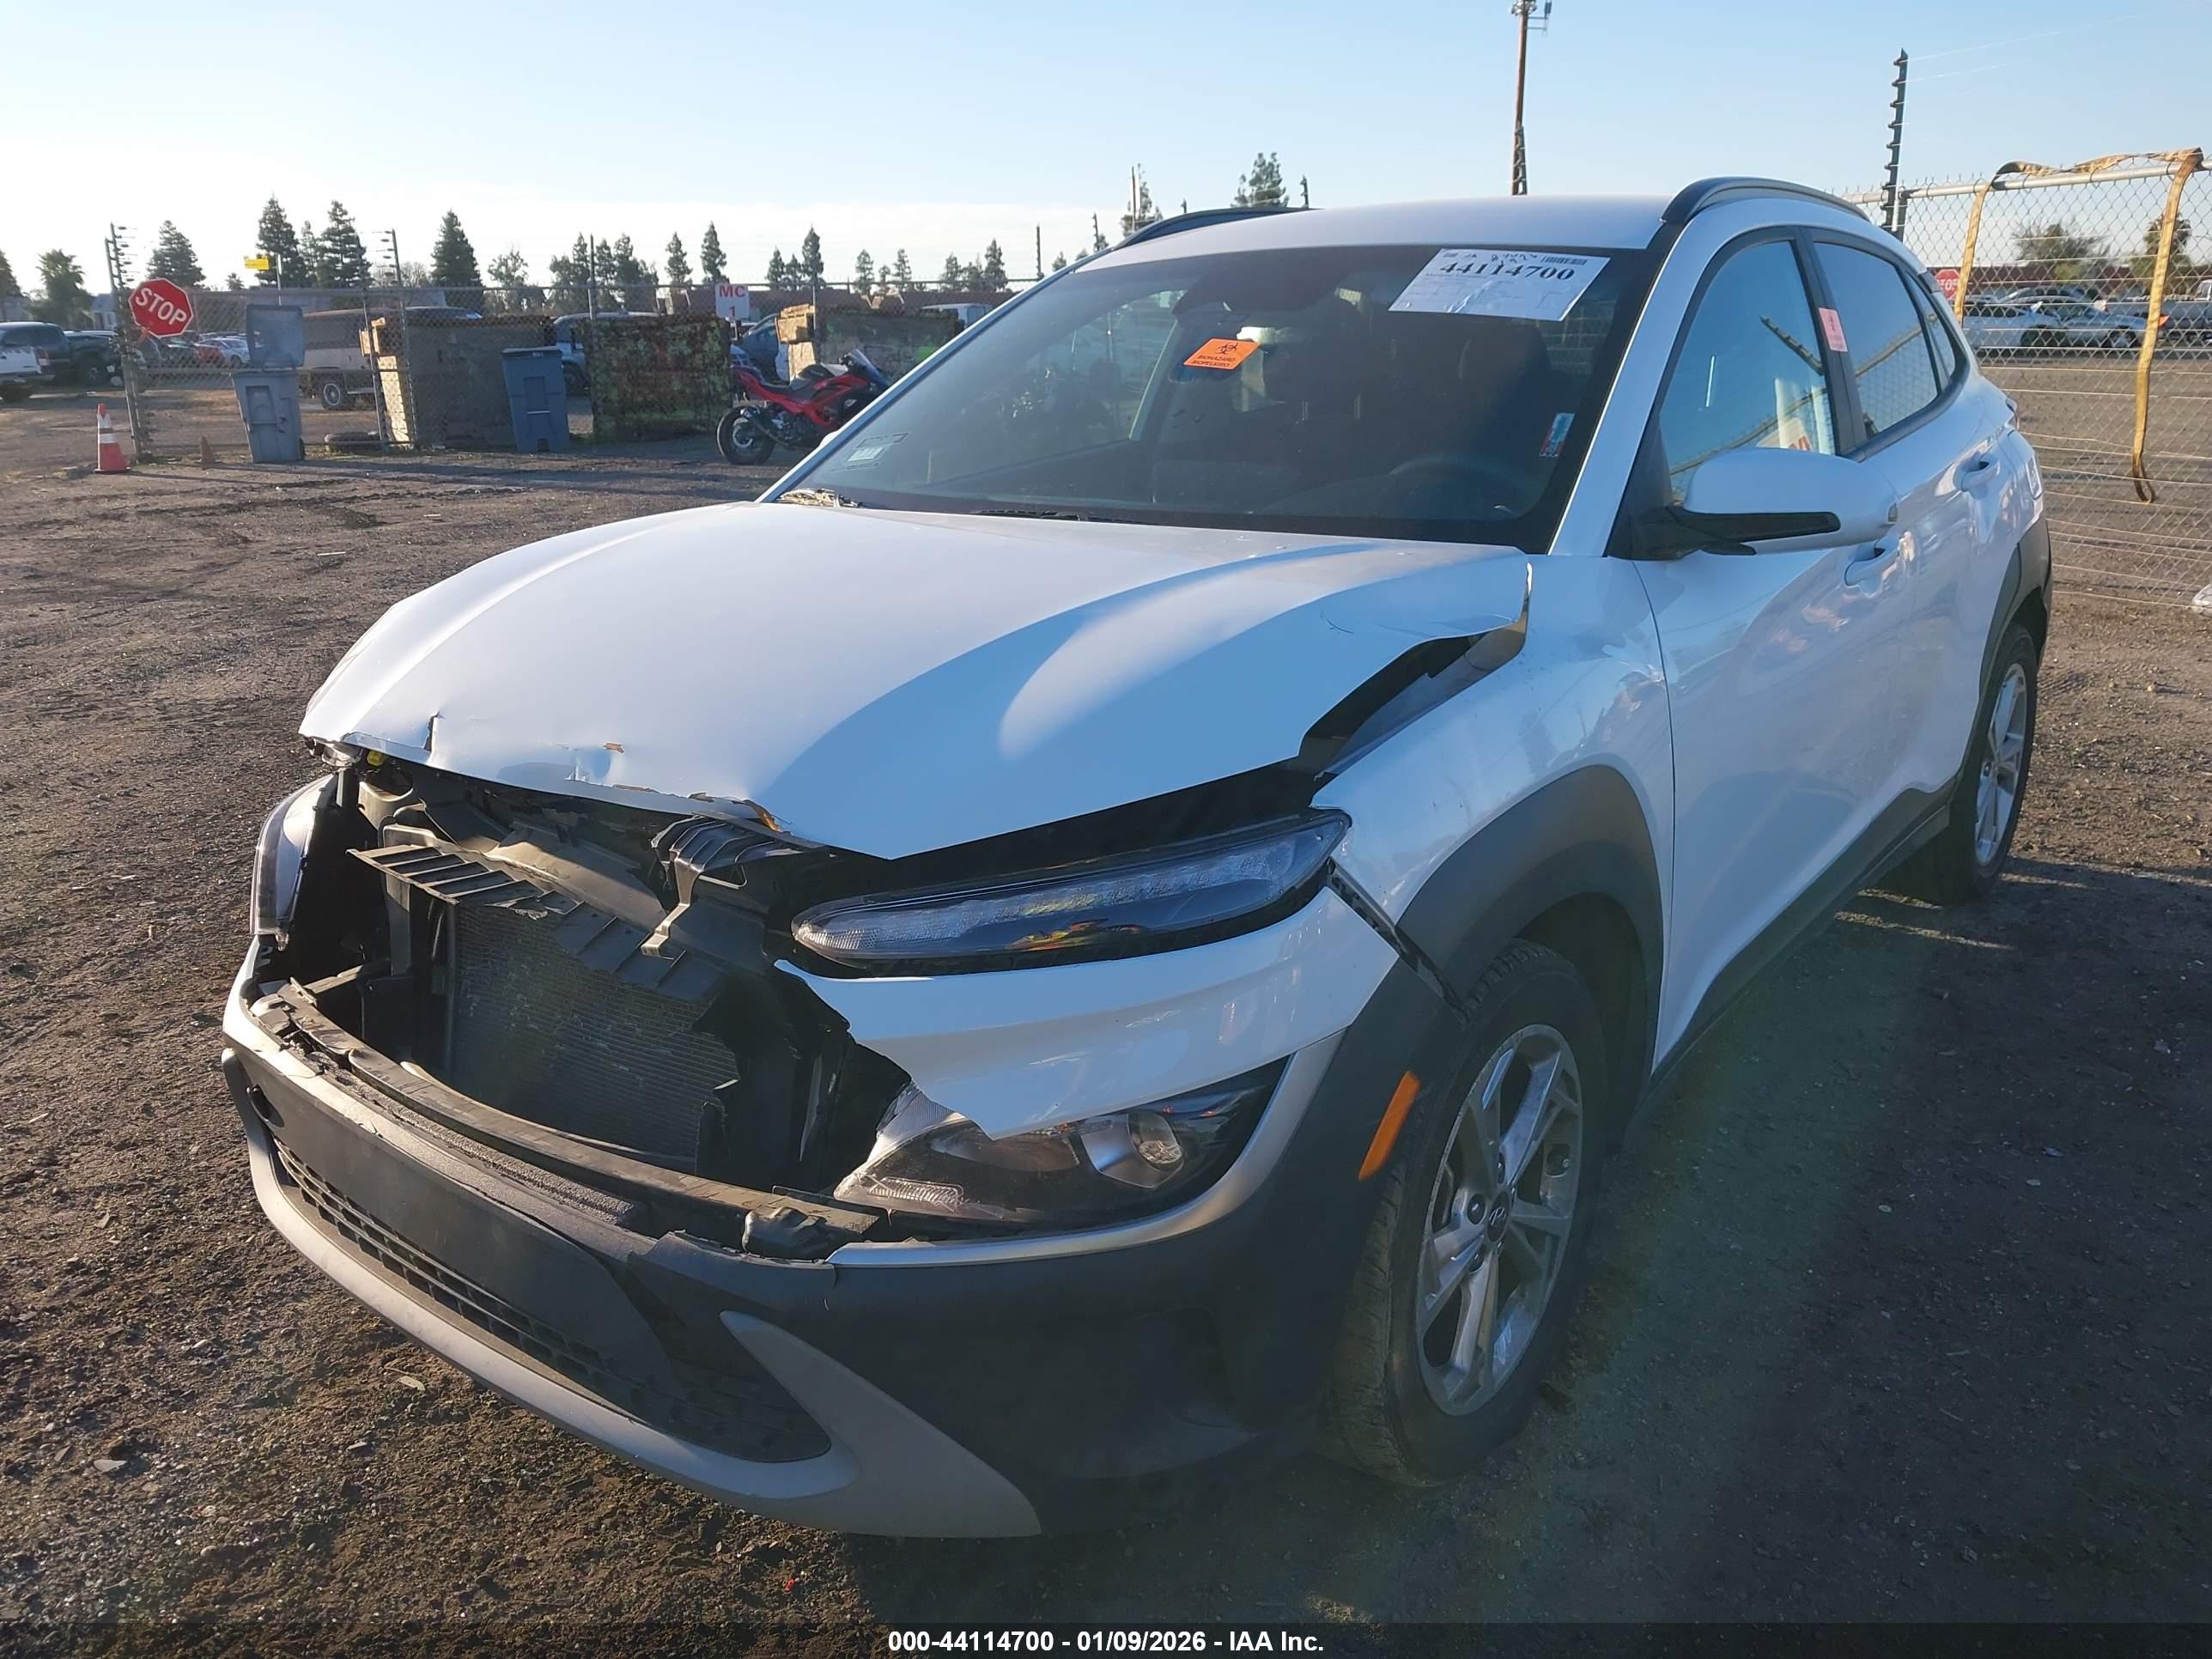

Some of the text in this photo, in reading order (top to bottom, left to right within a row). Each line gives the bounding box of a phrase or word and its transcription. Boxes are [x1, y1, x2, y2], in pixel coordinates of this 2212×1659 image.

[1440, 262, 1575, 280] 44114700
[719, 285, 746, 298] MC
[135, 287, 187, 325] STOP
[728, 305, 736, 317] 1
